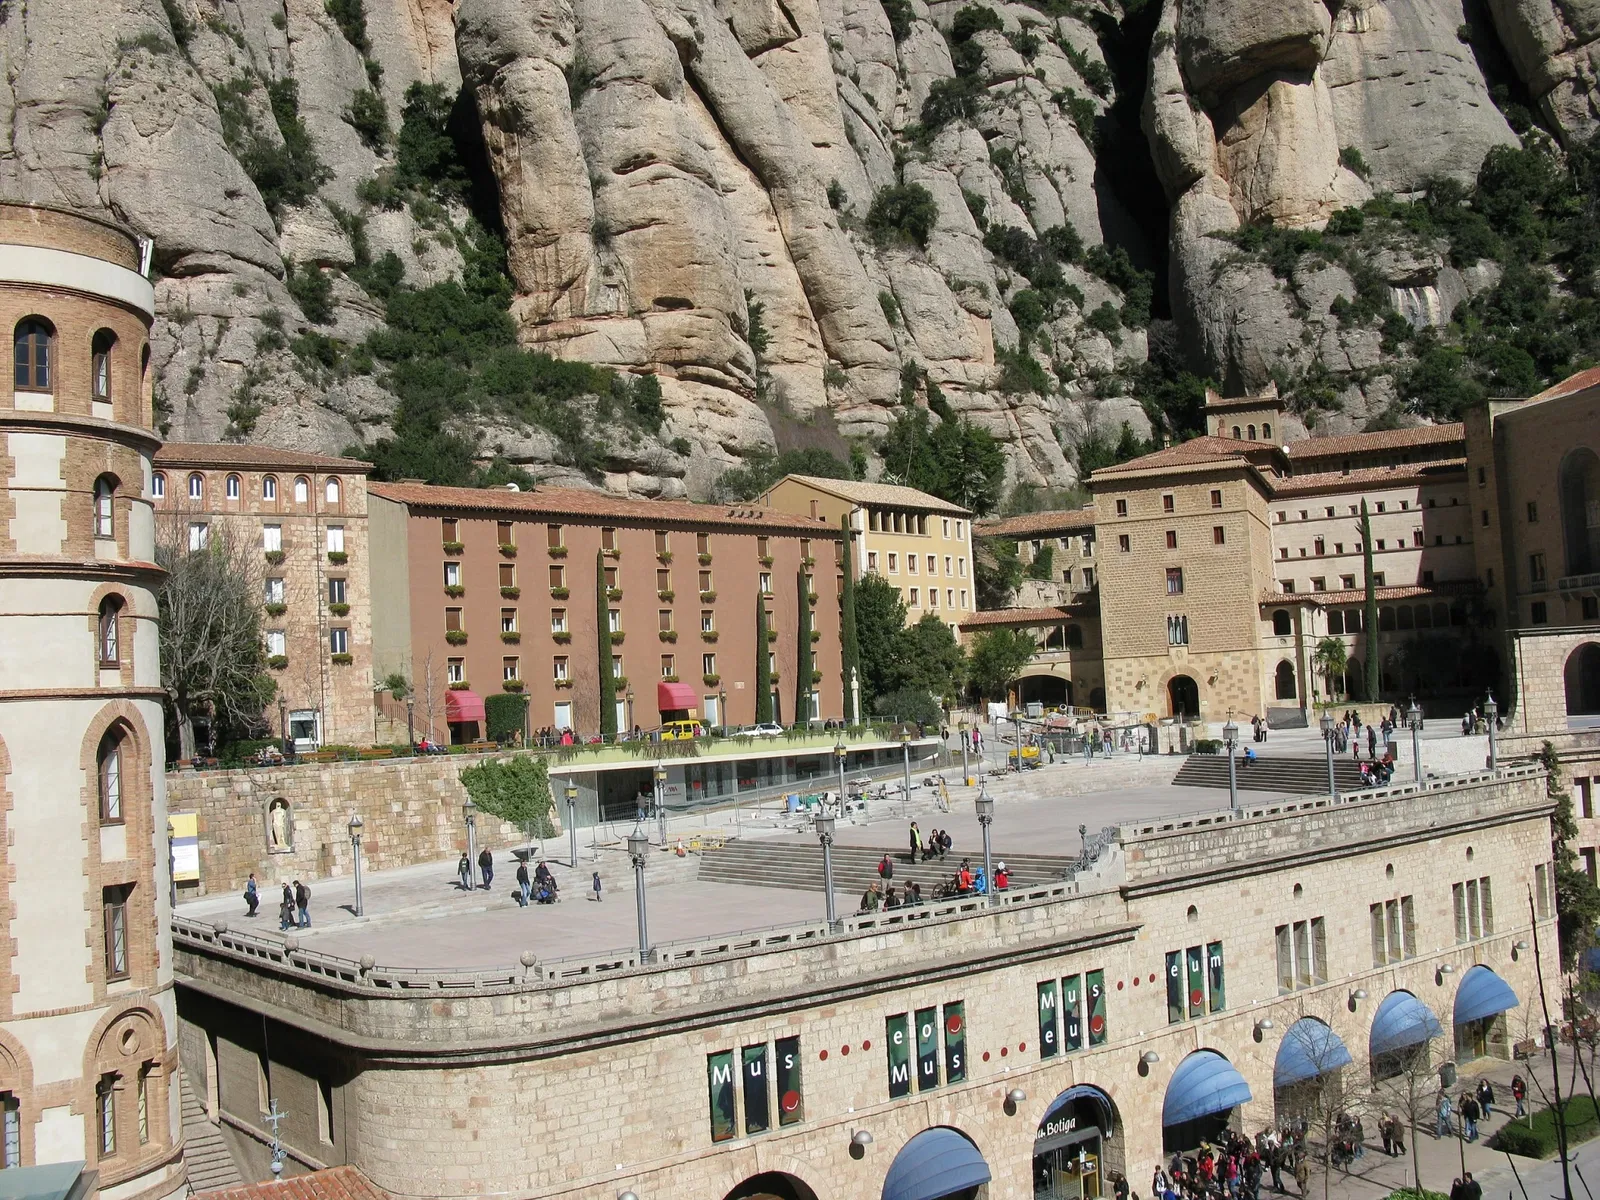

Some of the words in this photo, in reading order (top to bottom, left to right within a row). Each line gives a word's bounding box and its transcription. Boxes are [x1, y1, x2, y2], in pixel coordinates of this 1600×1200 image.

[1041, 983, 1100, 1010] Mus
[712, 1053, 794, 1085] Mus
[892, 1053, 961, 1084] Mus
[1046, 1117, 1076, 1136] Botiga
